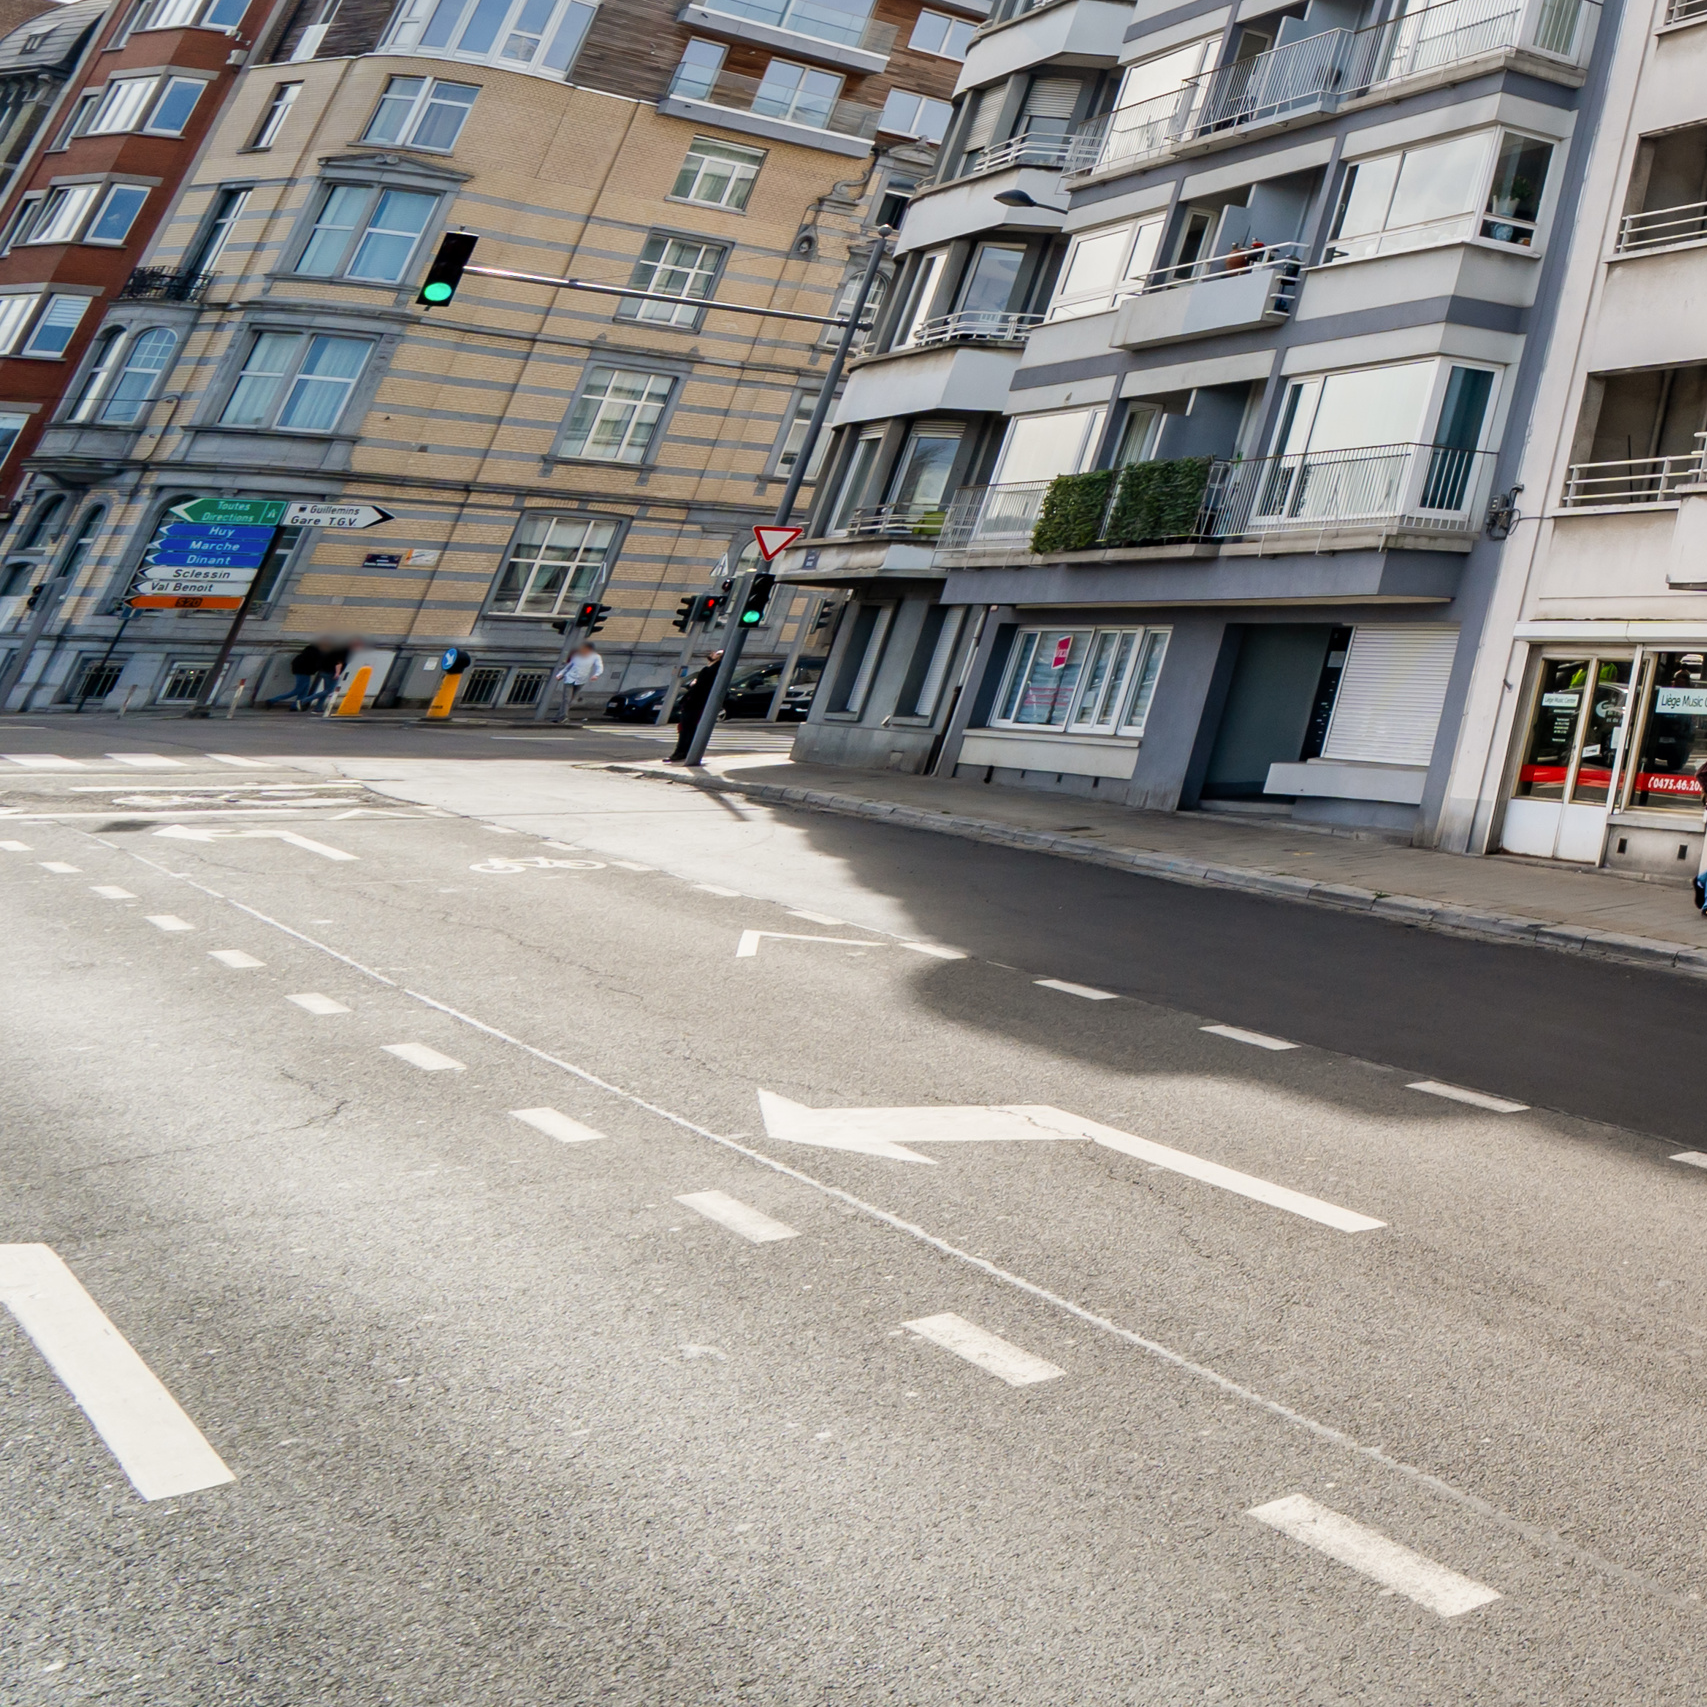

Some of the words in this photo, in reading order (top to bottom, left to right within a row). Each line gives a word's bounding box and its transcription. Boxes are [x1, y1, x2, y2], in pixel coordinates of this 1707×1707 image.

[217, 501, 251, 511] Toutes
[310, 504, 360, 516] Guillemins
[202, 512, 254, 523] Directions
[290, 516, 325, 526] Gare
[209, 526, 236, 538] Huy
[189, 540, 241, 552] Marche
[186, 555, 232, 565] Dinant
[173, 569, 231, 579] Sclessin
[151, 581, 169, 592] Val
[175, 597, 202, 608] S20
[1661, 694, 1680, 709] Liège
[1682, 695, 1703, 708] Music
